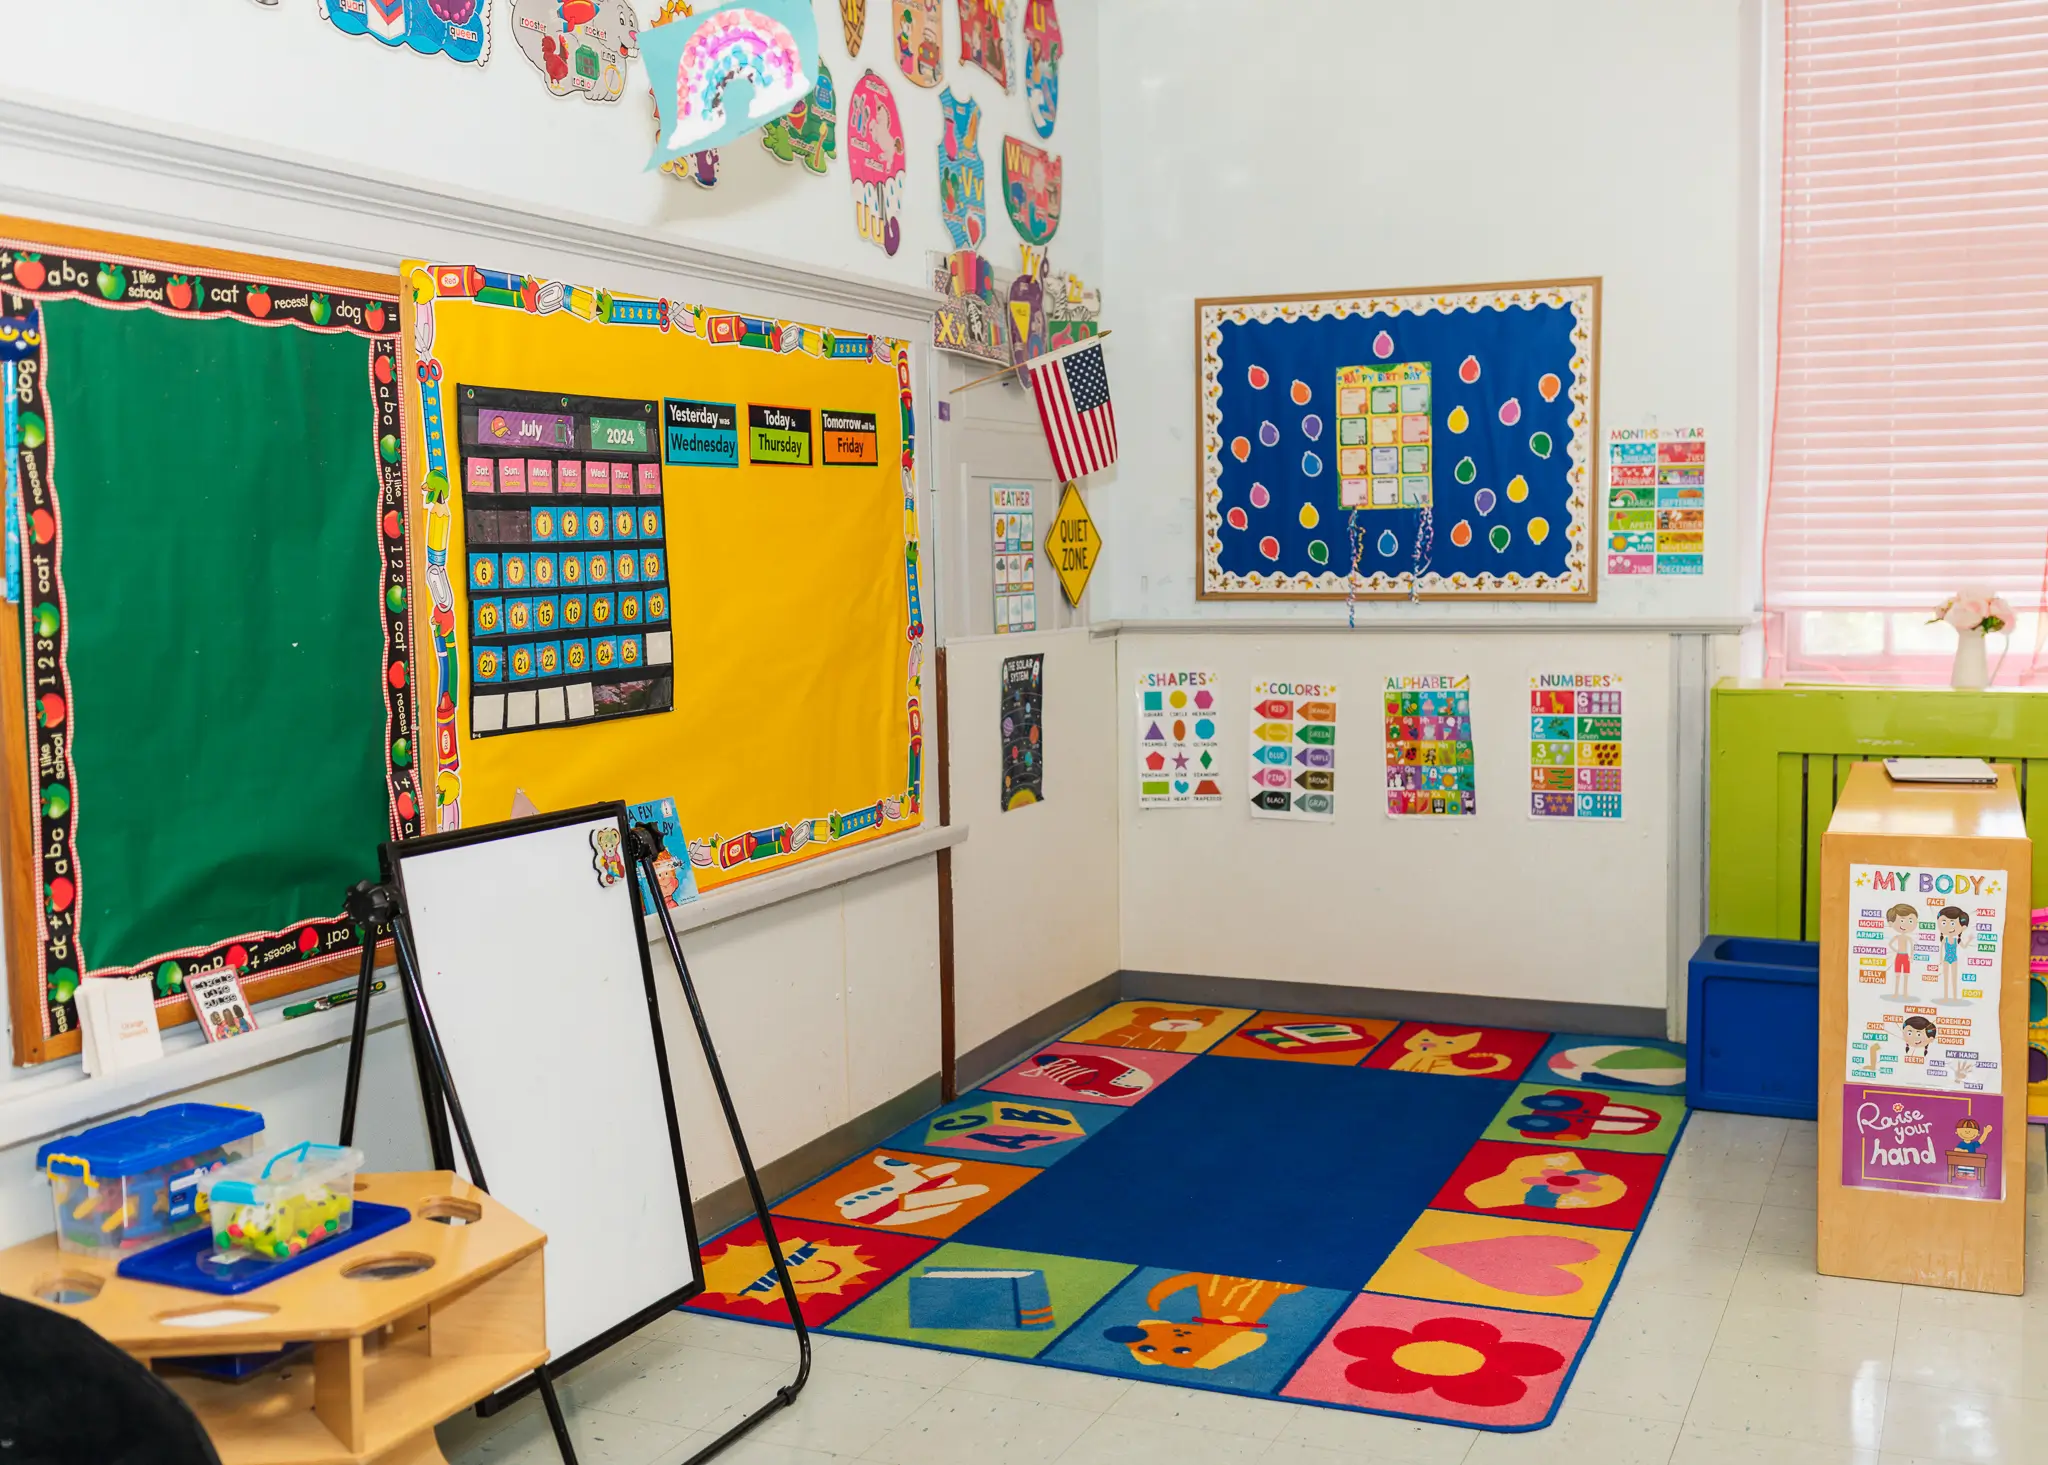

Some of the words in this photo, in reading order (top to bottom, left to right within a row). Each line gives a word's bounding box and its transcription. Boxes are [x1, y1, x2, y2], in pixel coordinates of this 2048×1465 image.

[450, 28, 477, 40] queen
[521, 18, 546, 32] rooster
[585, 26, 607, 39] rocket
[602, 52, 616, 63] ring
[48, 259, 89, 287] abc
[138, 270, 156, 287] like
[444, 276, 457, 285] Red
[128, 285, 163, 301] school
[211, 284, 238, 304] cat
[336, 299, 362, 324] dog
[17, 360, 36, 403] dog
[670, 404, 719, 428] Yesterday
[764, 410, 791, 430] Today
[791, 419, 796, 427] is
[823, 414, 861, 430] Tomorrow
[519, 420, 543, 441] July
[607, 428, 634, 445] 2024
[1611, 428, 1658, 440] MONTHS
[1675, 428, 1704, 438] YEAR
[671, 433, 736, 458] Wednesday
[758, 434, 802, 458] Thursday
[837, 438, 864, 457] Friday
[475, 466, 490, 475] Sat.
[504, 466, 520, 476] Sun.
[532, 468, 549, 477] Mon.
[562, 468, 577, 476] Tues.
[591, 468, 607, 478] Wed.
[385, 466, 395, 505] school
[393, 478, 402, 498] like
[994, 491, 1030, 506] WEATHER
[543, 521, 546, 532] 1
[568, 521, 573, 532] 2
[594, 520, 598, 531] 3
[622, 520, 627, 531] 4
[649, 520, 653, 530] 5
[1060, 520, 1088, 543] QUIET
[1062, 548, 1088, 571] ZONE
[33, 554, 50, 593] cat
[482, 568, 486, 580] 6
[514, 567, 518, 578] 7
[542, 566, 546, 578] 8
[570, 566, 574, 577] 9
[594, 565, 603, 576] 10
[622, 563, 630, 574] 11
[648, 562, 656, 573] 12
[483, 612, 493, 625] 13
[514, 612, 524, 624] 14
[542, 610, 550, 621] 15
[569, 608, 578, 619] 16
[597, 606, 606, 618] 17
[626, 605, 634, 616] 18
[653, 601, 660, 612] 19
[394, 621, 408, 652] cat
[483, 660, 492, 672] 20
[518, 658, 526, 670] 21
[545, 654, 553, 666] 22
[572, 652, 581, 663] 23
[600, 649, 609, 661] 24
[626, 648, 634, 658] 25
[1016, 658, 1033, 669] SOLAR
[1010, 671, 1029, 683] SYSTEM
[1148, 672, 1206, 686] SHAPES
[1387, 676, 1455, 690] ALPHABET
[1541, 675, 1610, 687] NUMBERS
[1270, 683, 1320, 696] COLORS
[40, 743, 52, 766] like
[51, 733, 65, 780] school
[628, 809, 637, 822] A
[638, 805, 653, 819] FLY
[663, 822, 673, 836] BY
[1873, 871, 1911, 891] MY
[1919, 873, 1985, 895] BODY
[326, 929, 349, 949] cat
[192, 973, 234, 990] CIRCLE
[204, 985, 230, 998] TIME
[204, 994, 237, 1009] RULES
[1856, 1102, 1924, 1134] Raise
[1894, 1122, 1932, 1144] your
[1870, 1137, 1936, 1166] hand
